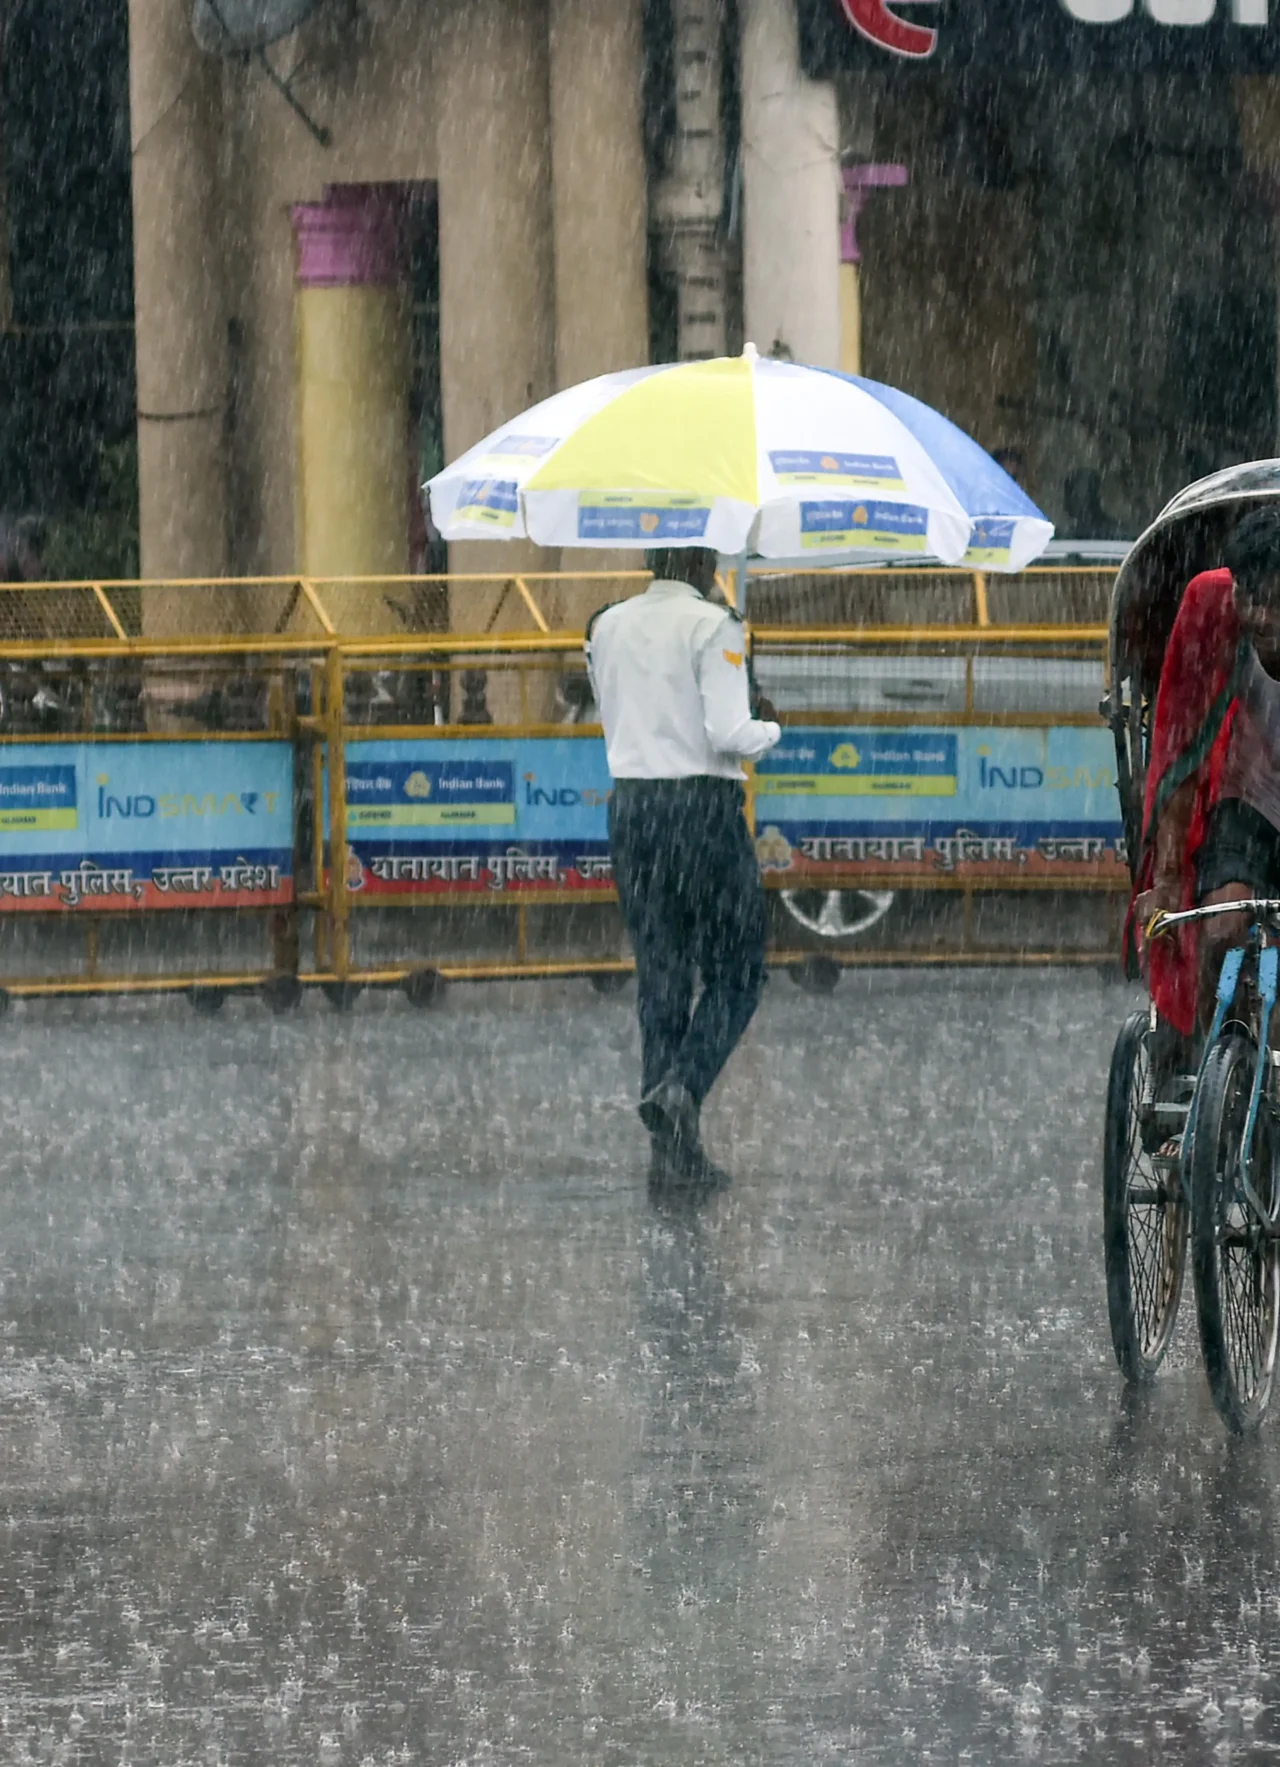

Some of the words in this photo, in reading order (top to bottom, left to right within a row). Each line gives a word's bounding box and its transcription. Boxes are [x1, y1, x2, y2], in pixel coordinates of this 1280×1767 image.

[37, 781, 67, 794] Bank
[438, 778, 473, 790] Indian
[371, 856, 479, 880] यातायात
[60, 860, 143, 905] पुलिस,
[152, 866, 212, 892] उत्तर
[220, 856, 279, 890] प्रदेश
